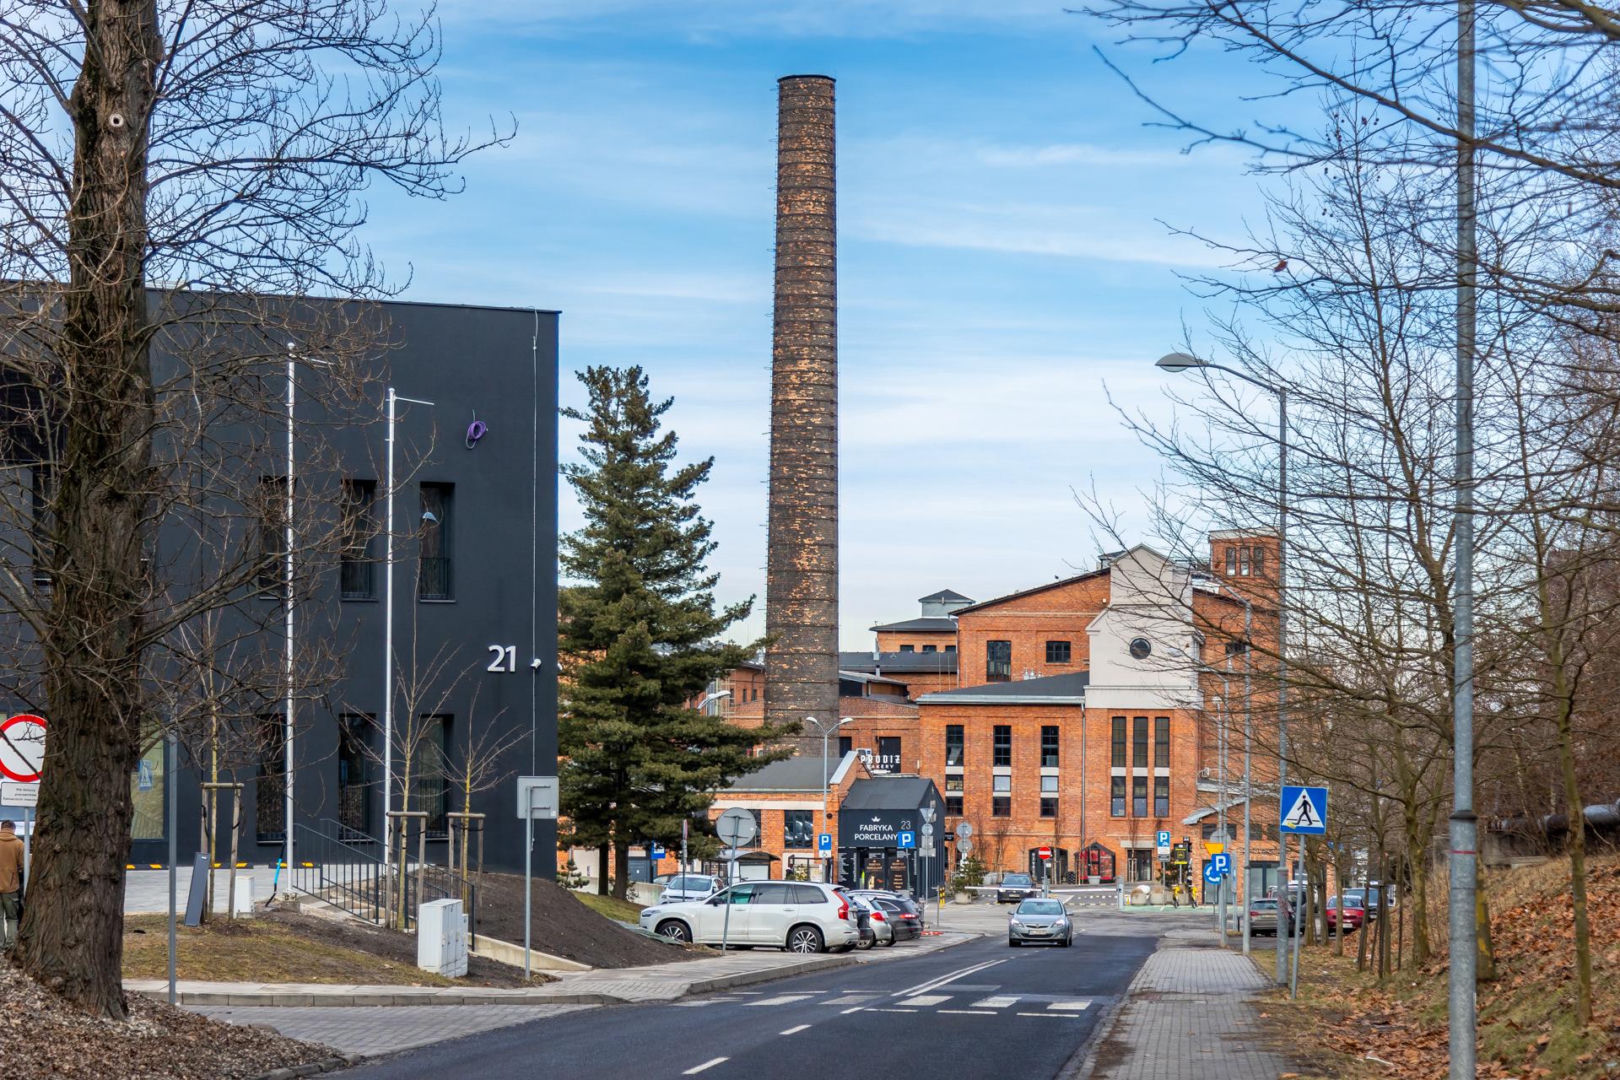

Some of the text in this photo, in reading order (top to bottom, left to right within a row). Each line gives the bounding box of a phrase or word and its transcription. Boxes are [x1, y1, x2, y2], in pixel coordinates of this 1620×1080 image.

[487, 644, 517, 673] 21
[900, 820, 911, 830] 23
[821, 836, 829, 846] P
[902, 834, 912, 846] P
[1160, 832, 1168, 843] P
[1215, 855, 1226, 872] P
